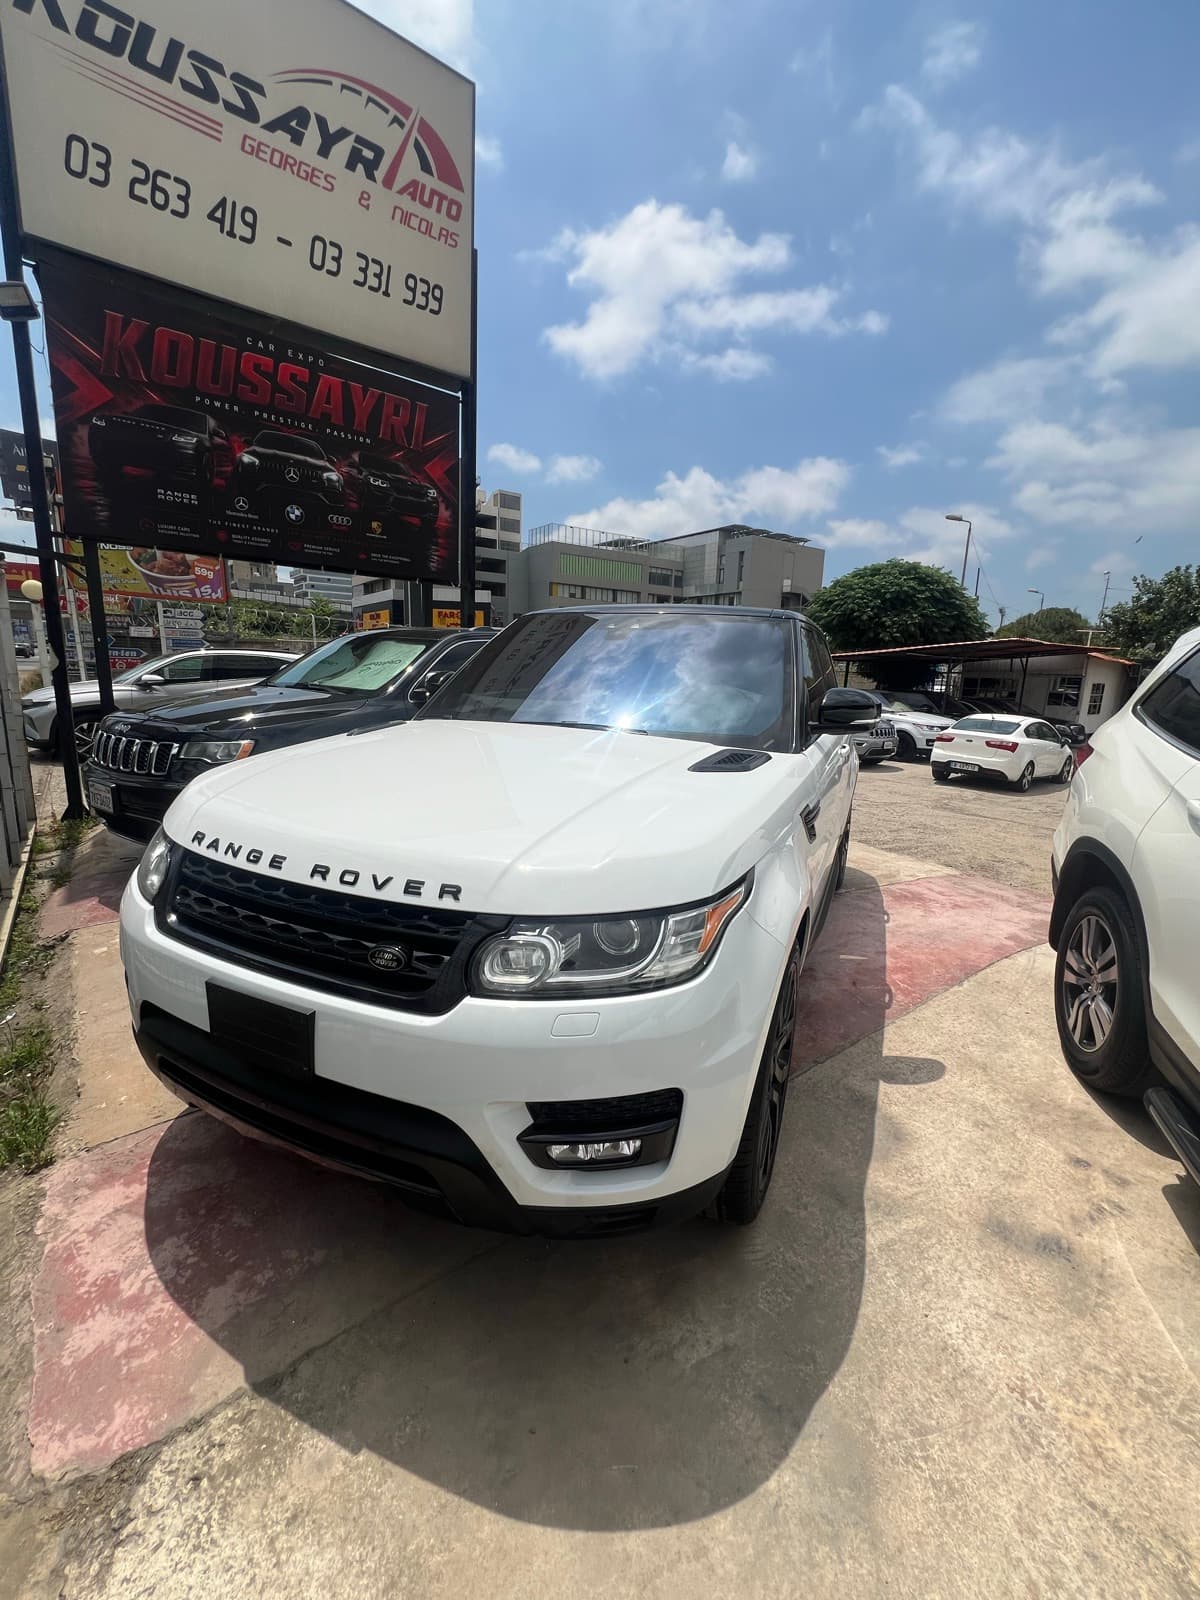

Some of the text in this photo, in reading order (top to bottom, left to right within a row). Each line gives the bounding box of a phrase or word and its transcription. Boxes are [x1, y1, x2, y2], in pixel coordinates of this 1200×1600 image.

[240, 133, 460, 249] GEORGES & NICOLAS
[396, 178, 463, 223] AUTO
[64, 133, 444, 316] 03 263 419 - 03 331 939
[246, 336, 325, 367] CAR EXPO
[101, 309, 430, 450] KOUSSAYRI
[157, 488, 198, 500] RANGE
[157, 494, 198, 505] ROVER
[194, 566, 214, 579] 59g
[191, 830, 463, 902] RANGE ROVER
[374, 958, 398, 968] ROVER
[375, 951, 393, 960] LAND
